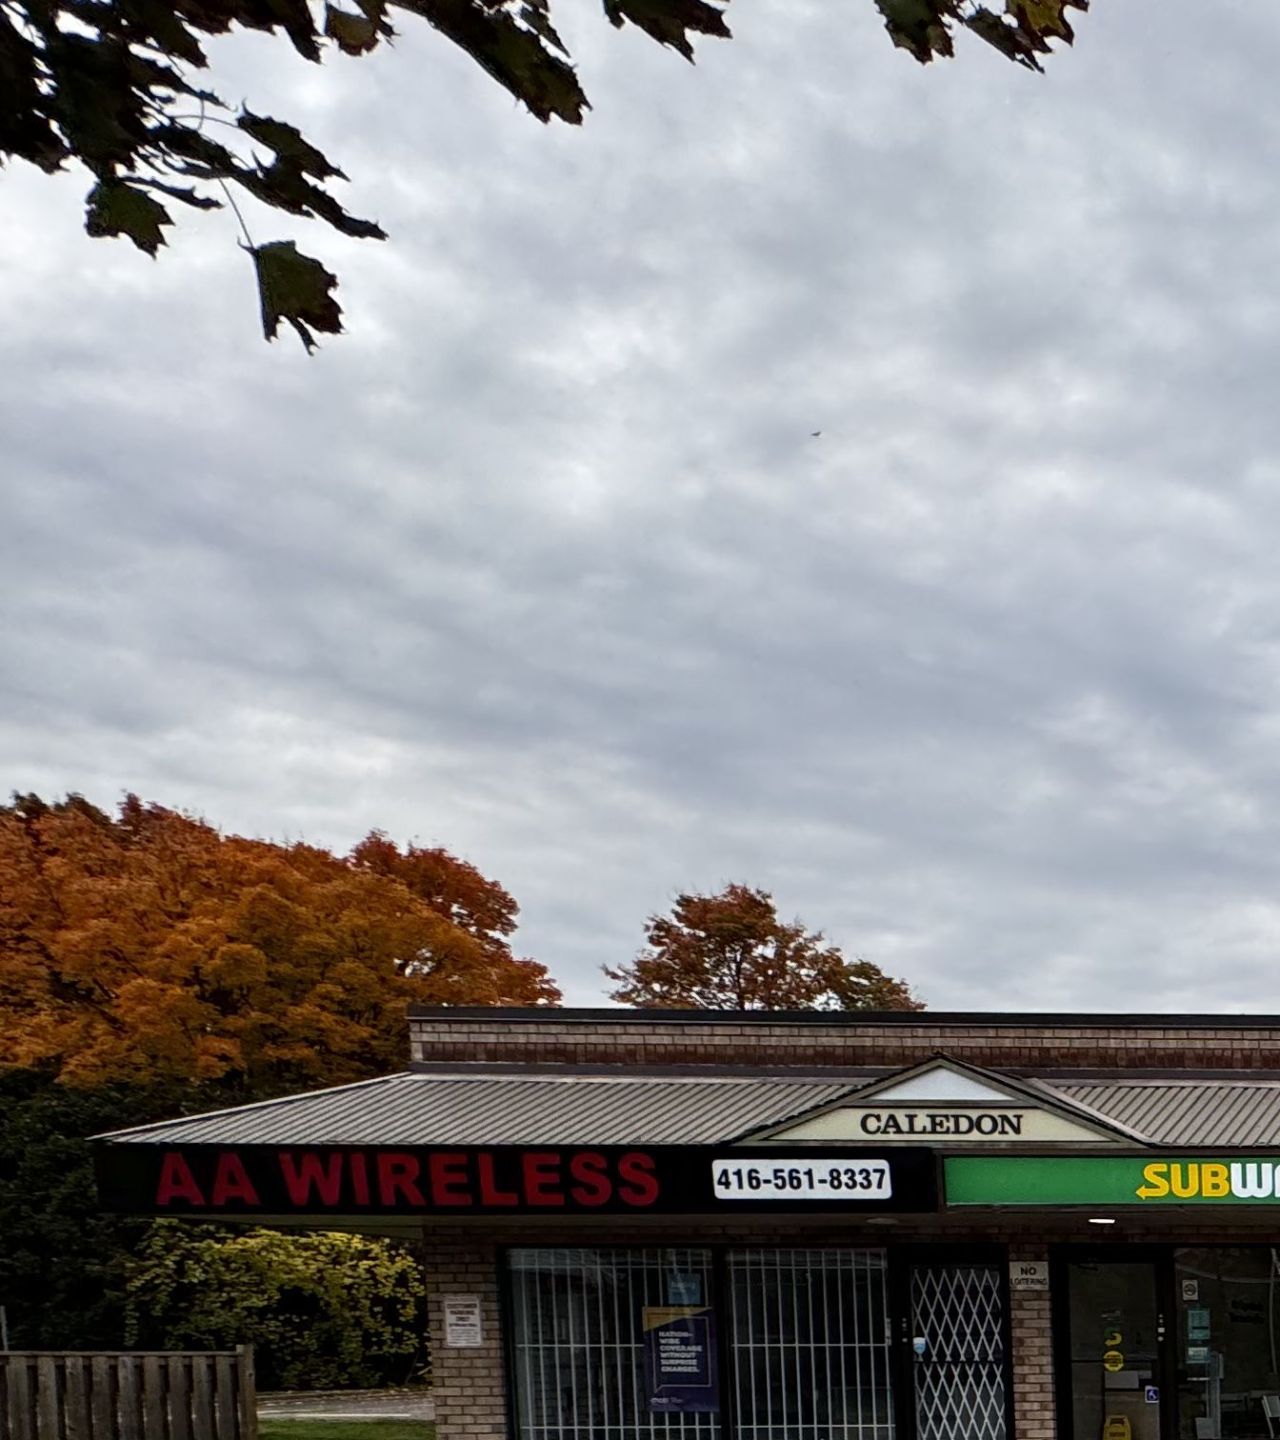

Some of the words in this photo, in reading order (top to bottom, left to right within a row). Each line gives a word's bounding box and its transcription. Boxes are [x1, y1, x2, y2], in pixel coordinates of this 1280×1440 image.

[860, 1114, 1024, 1135] CALEDON
[155, 1152, 262, 1206] AA
[278, 1152, 661, 1207] WIRELESS
[717, 1168, 886, 1191] 416-561-8337
[1020, 1267, 1037, 1275] NO
